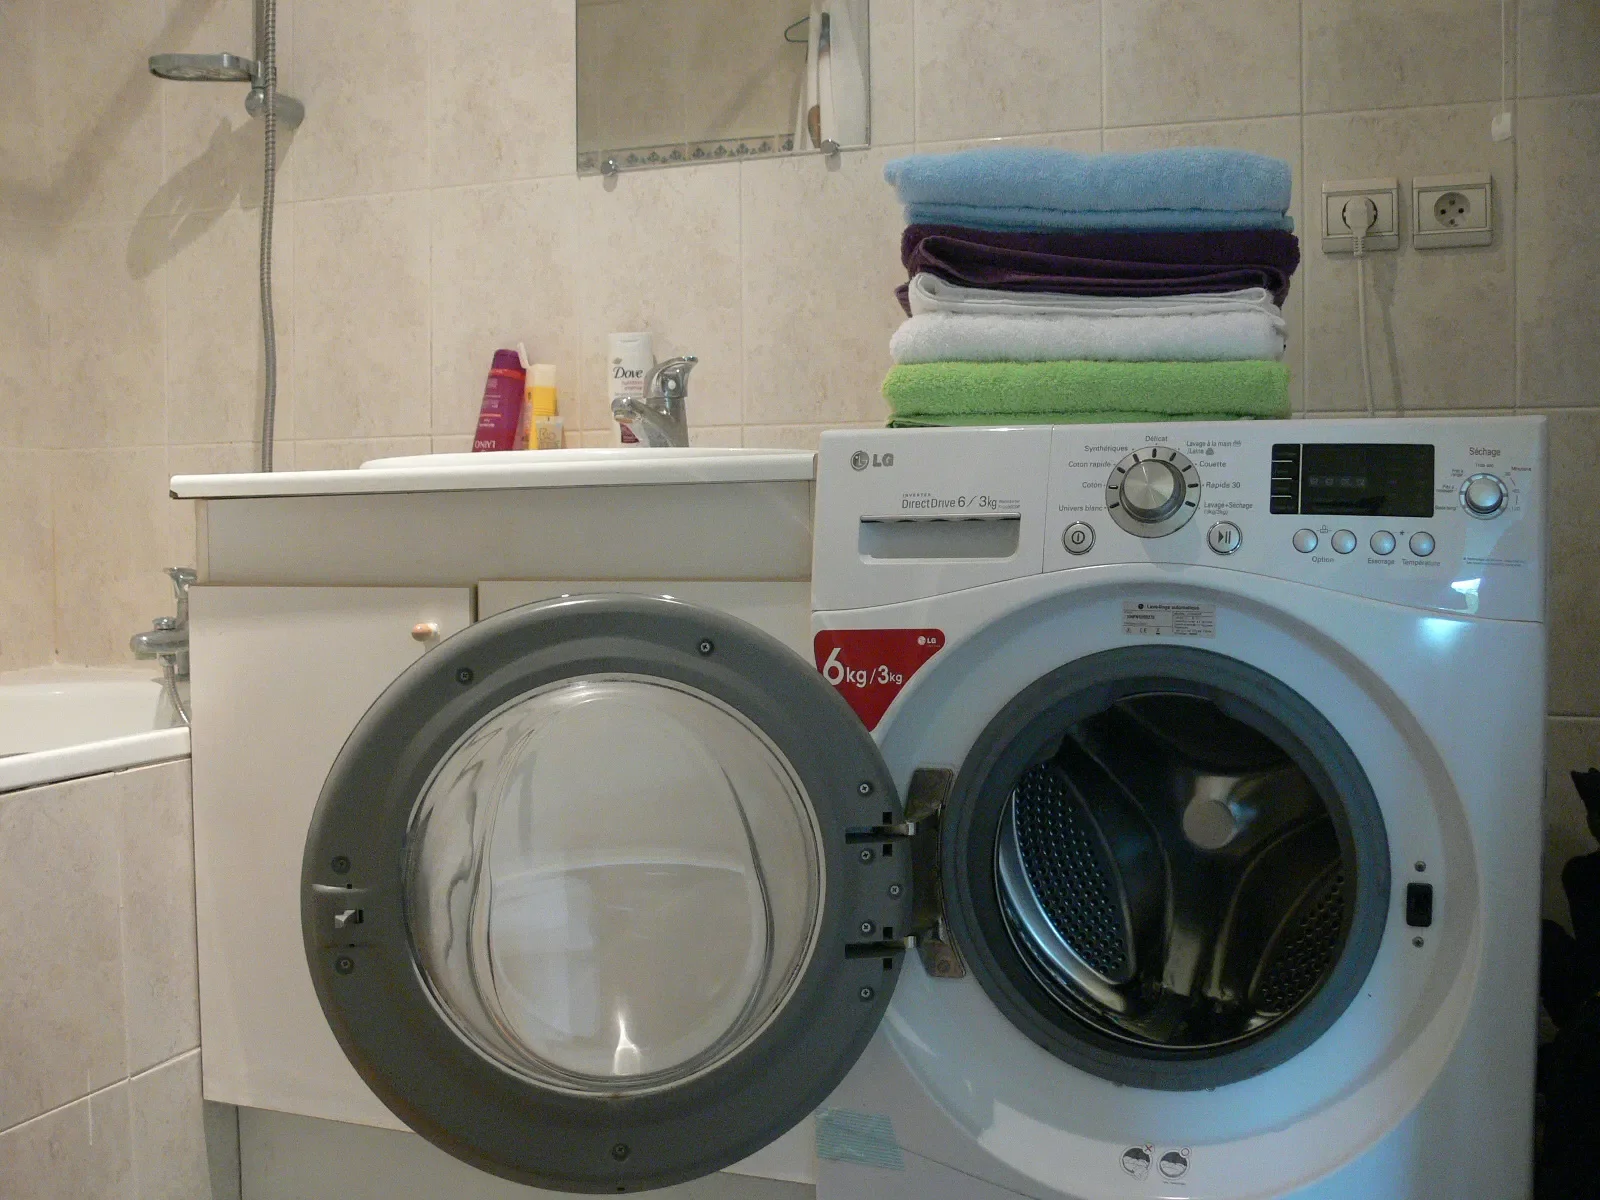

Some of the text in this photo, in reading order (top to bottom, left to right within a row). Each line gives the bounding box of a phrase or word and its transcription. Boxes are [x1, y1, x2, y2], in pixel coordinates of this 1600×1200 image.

[613, 366, 644, 379] Dove
[1145, 434, 1168, 442] Délicat
[1469, 446, 1501, 457] Séchage
[872, 453, 895, 467] LG
[1089, 460, 1111, 469] rapide
[1199, 460, 1226, 468] Couette
[1082, 481, 1103, 489] Coton
[1205, 481, 1241, 490] Rapide 30
[1059, 504, 1103, 512] Univers blanc
[1311, 555, 1334, 564] Option
[1367, 557, 1395, 566] Essorage
[1402, 558, 1441, 567] Température
